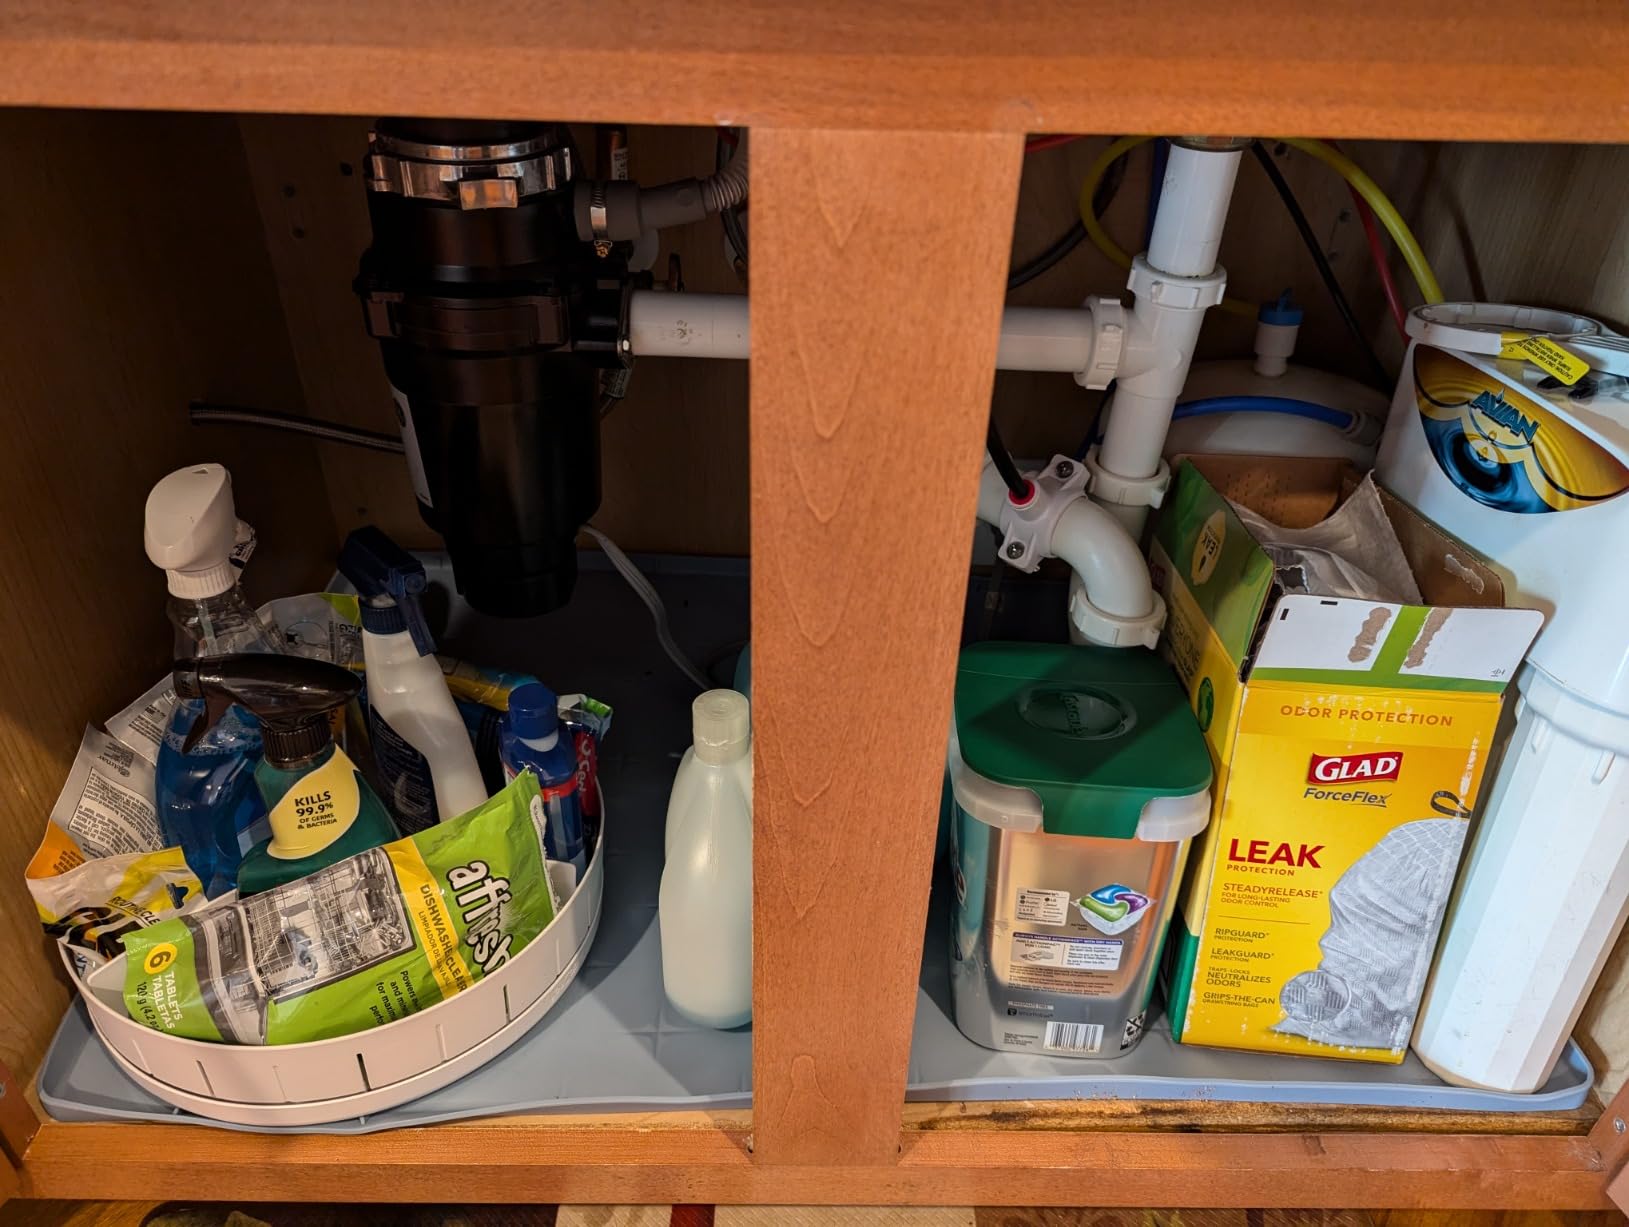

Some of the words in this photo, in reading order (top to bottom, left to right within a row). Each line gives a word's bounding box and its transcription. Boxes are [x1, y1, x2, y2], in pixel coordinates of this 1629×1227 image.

[1280, 705, 1332, 719] ODOR
[1338, 709, 1453, 726] PROTECTION
[1314, 757, 1397, 781] GLAD
[294, 790, 331, 806] KILLS
[1303, 787, 1392, 806] ForceFlex
[296, 802, 334, 816] 99.9%
[306, 818, 337, 828] BACTERIA
[312, 813, 334, 822] GERMS
[1228, 838, 1326, 868] LEAK
[1226, 864, 1295, 876] PROTECTION
[1238, 894, 1290, 903] LONG-LASTING
[1244, 900, 1279, 908] CONTROL
[1216, 928, 1265, 938] RIPGUARD
[150, 951, 171, 968] 6
[1212, 948, 1271, 960] LEAKGUARD
[400, 970, 415, 998] Powers
[1206, 978, 1241, 988] ODORS
[1208, 972, 1272, 984] NEUTRALIZES
[137, 982, 148, 996] 120
[376, 981, 384, 994] for
[390, 981, 402, 997] and
[152, 975, 176, 1029] TABLETAS
[165, 971, 183, 1020] TABLETS
[1204, 992, 1276, 1004] GRIPS-THE-CAN
